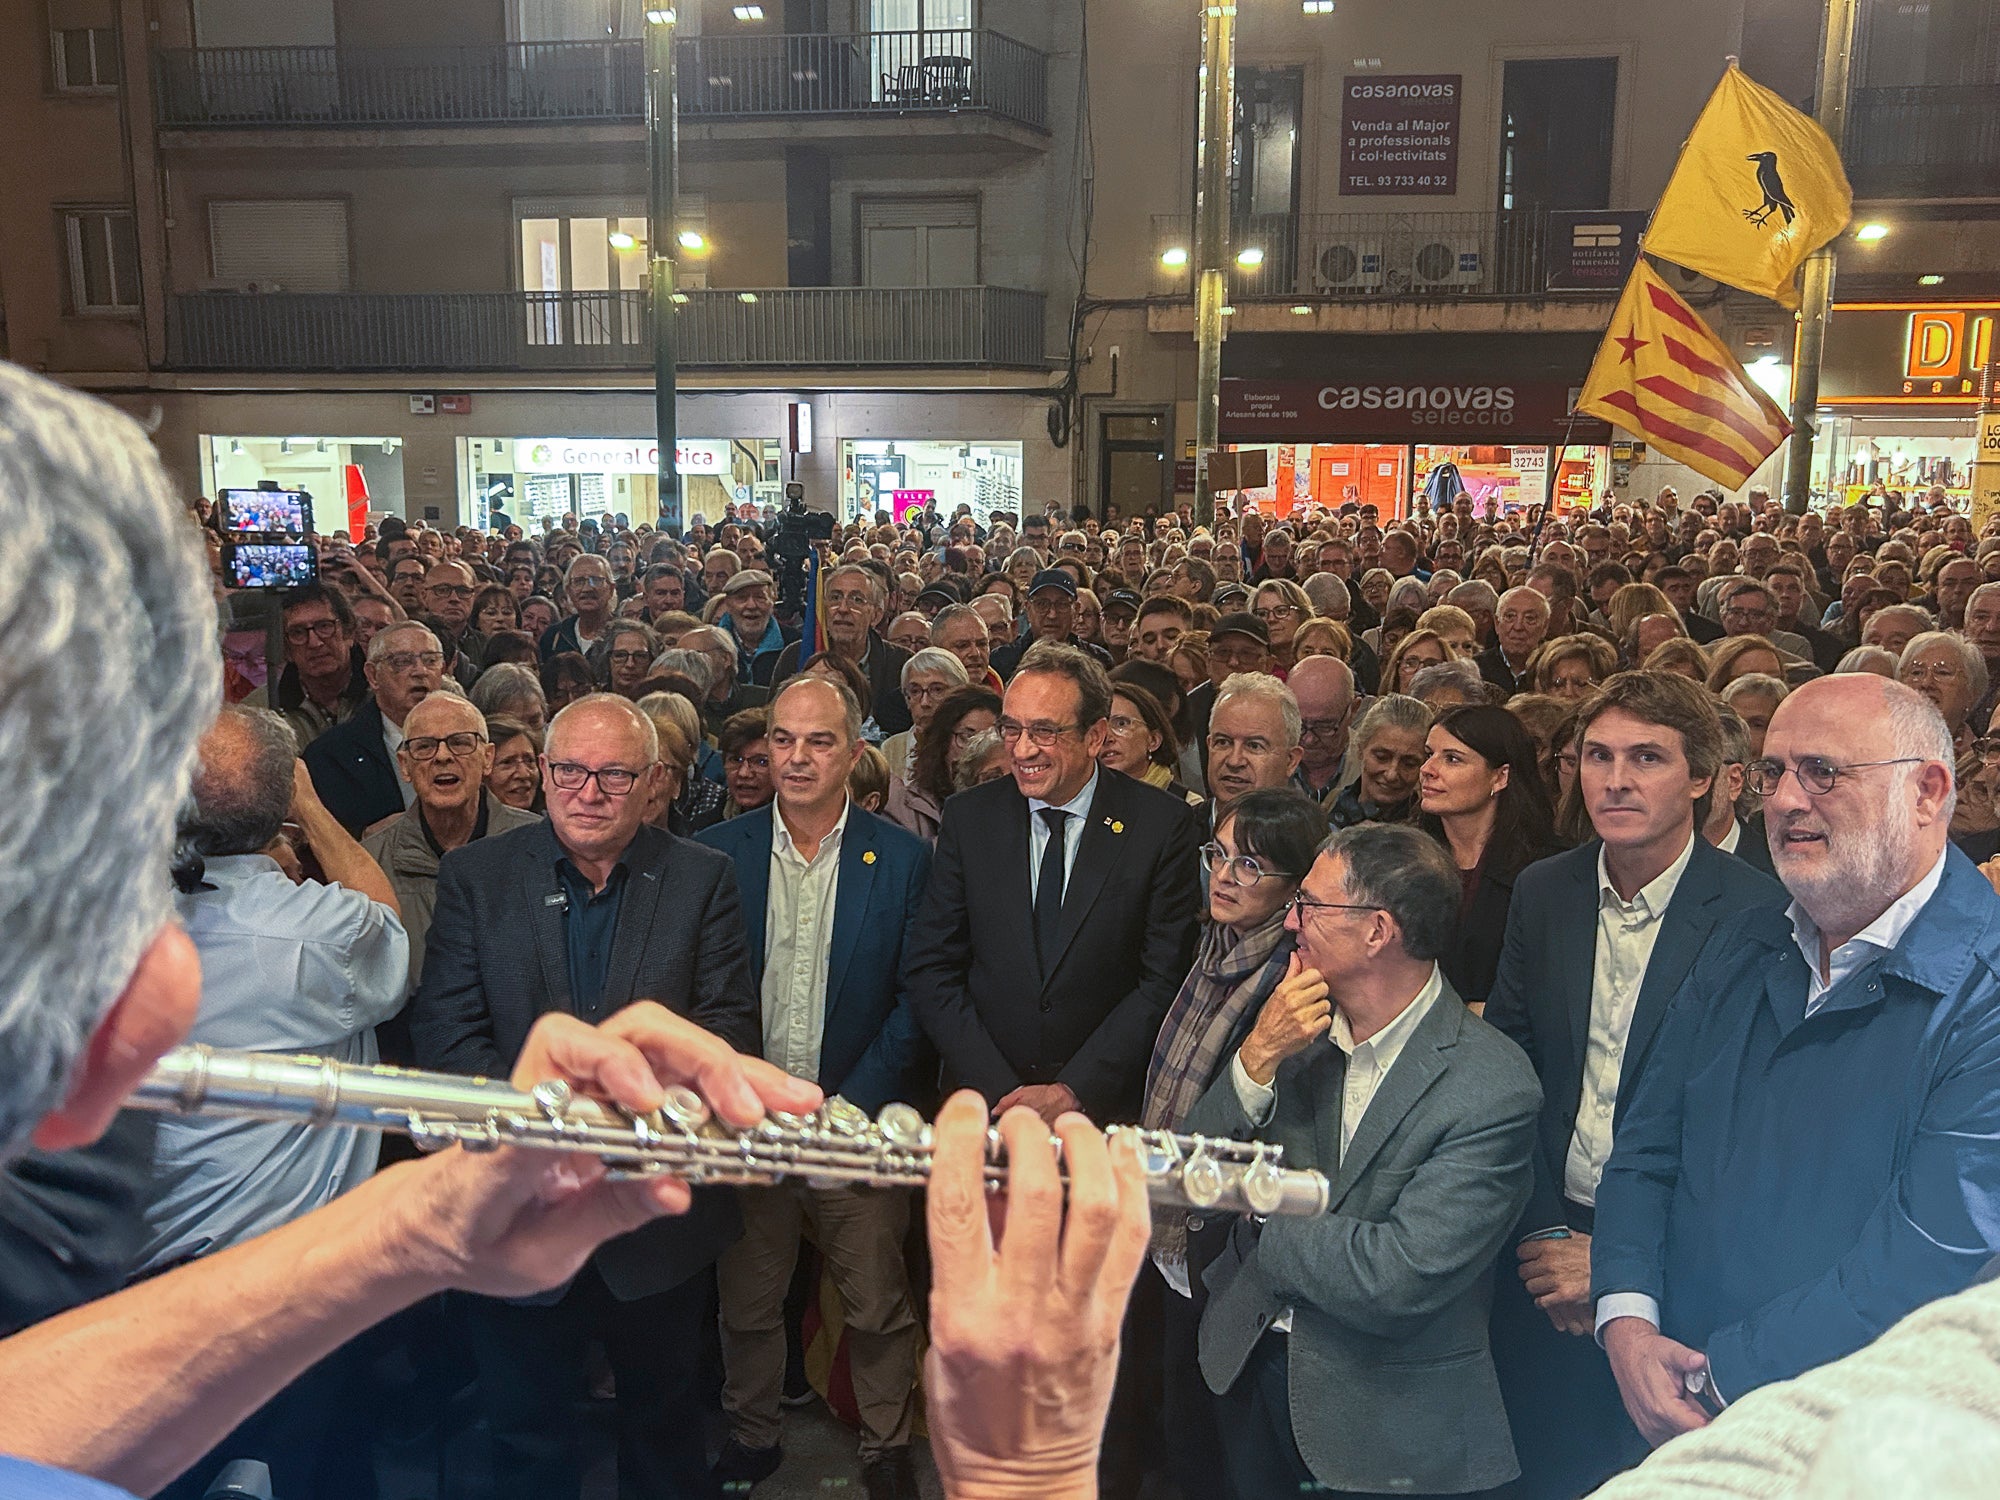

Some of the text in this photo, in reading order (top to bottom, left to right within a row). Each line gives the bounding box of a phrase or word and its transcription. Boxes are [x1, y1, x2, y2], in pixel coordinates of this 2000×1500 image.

[1350, 83, 1454, 98] casanovas
[1351, 120, 1450, 133] Venda al Major
[1348, 135, 1451, 148] a professionals
[1351, 150, 1447, 161] i col·lectivitats
[1349, 176, 1448, 187] TEL. 93 733 40 32
[1244, 393, 1280, 401] Elaboració
[1317, 386, 1515, 410] casanovas
[1250, 402, 1273, 410] propia
[1410, 408, 1514, 426] selecció
[563, 447, 641, 465] General
[1513, 457, 1544, 467] 32743
